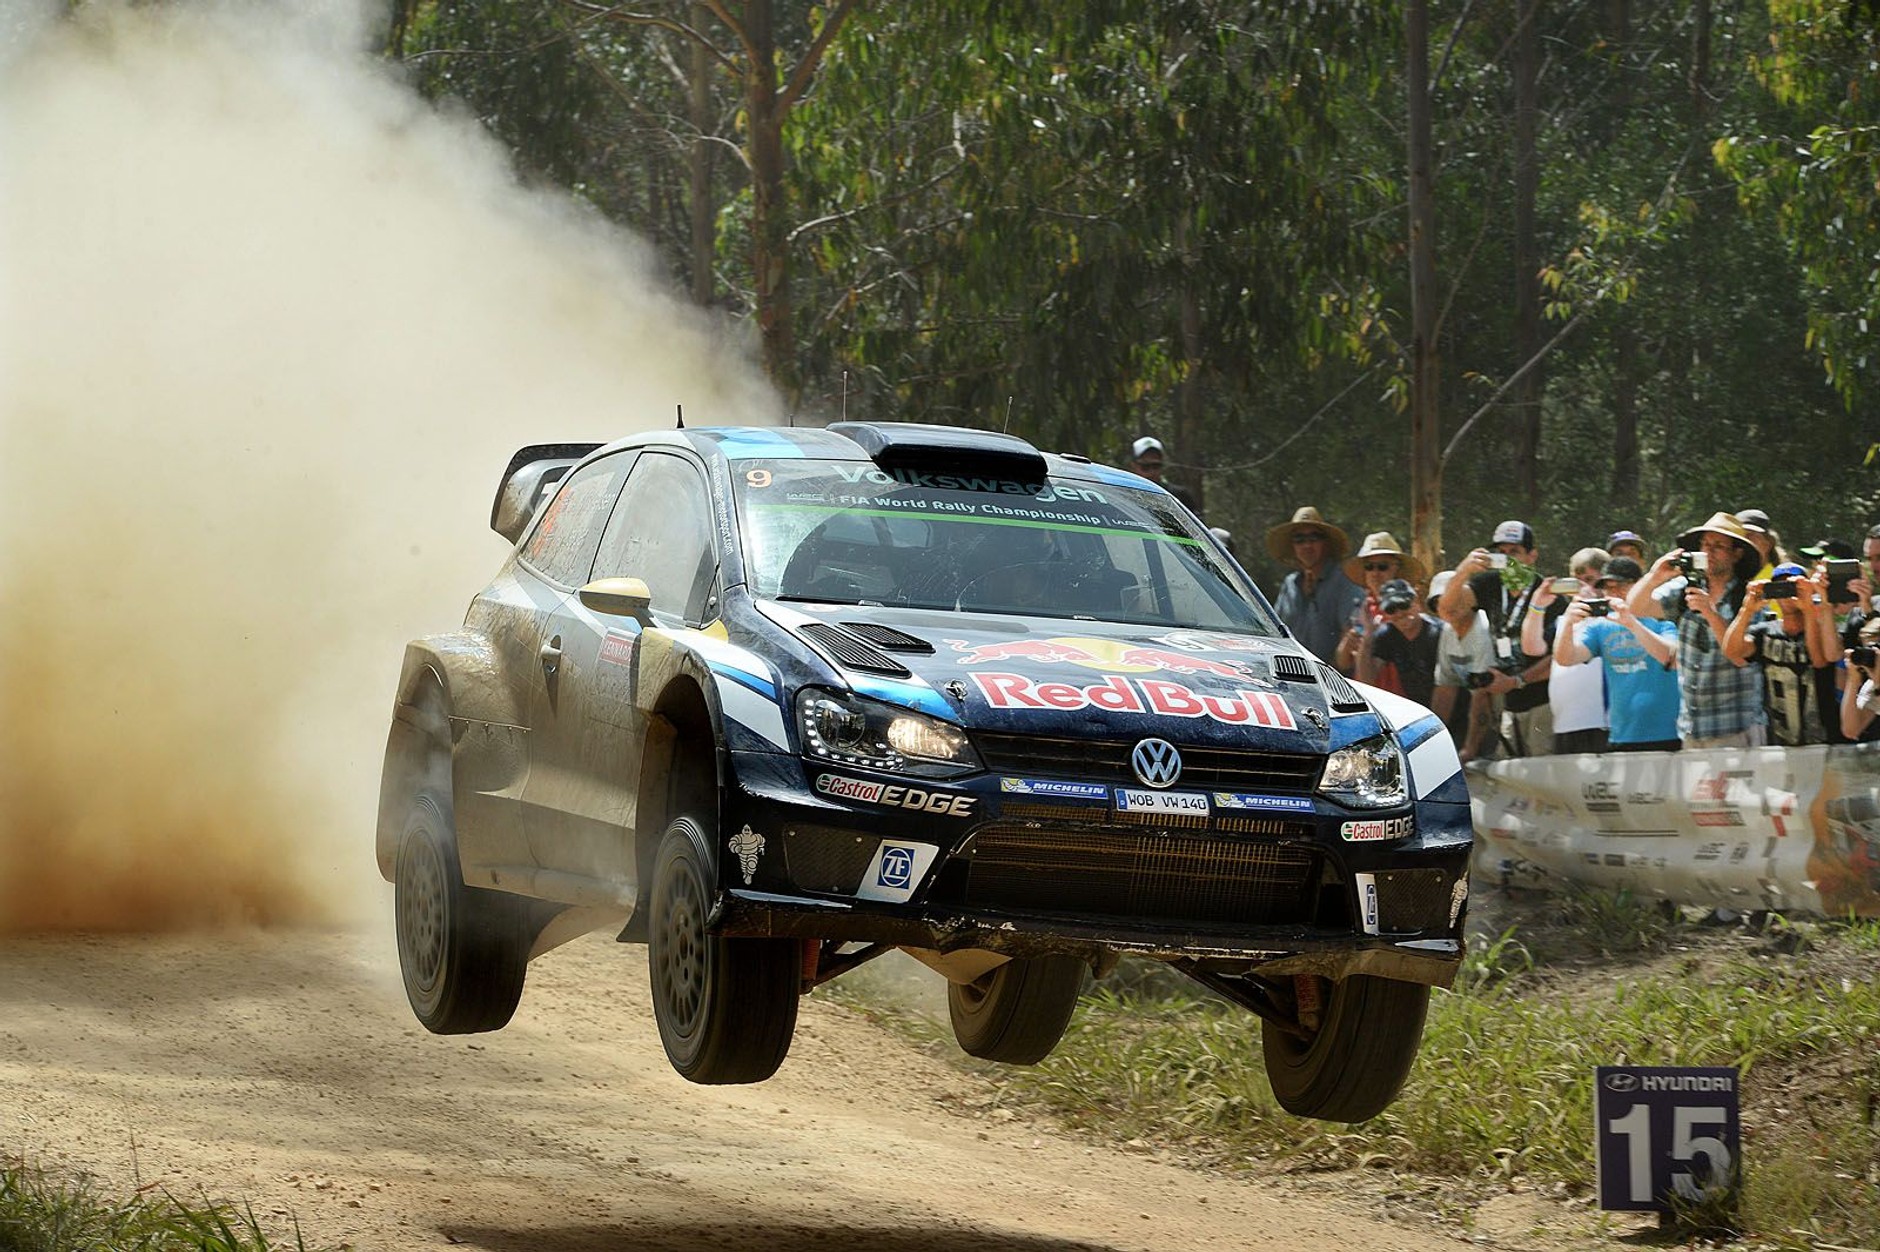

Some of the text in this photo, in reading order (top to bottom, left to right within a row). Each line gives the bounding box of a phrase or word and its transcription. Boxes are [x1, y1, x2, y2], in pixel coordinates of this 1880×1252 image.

[746, 469, 772, 488] 9
[831, 465, 1108, 504] Volkswagen
[839, 494, 871, 506] FIA
[874, 497, 927, 509] World
[932, 500, 976, 514] Rally
[982, 503, 1101, 525] Championship
[971, 672, 1297, 731] Red Bull
[828, 777, 979, 818] Castrol EDGE
[1032, 782, 1105, 795] MICHELIN
[1127, 793, 1207, 810] WOB VW 140
[1245, 796, 1311, 808] MICHELIN
[1353, 814, 1414, 840] Castrol EDGE
[882, 854, 910, 881] ZF
[1641, 1076, 1733, 1092] HYUNDAI
[1608, 1103, 1732, 1202] 15
